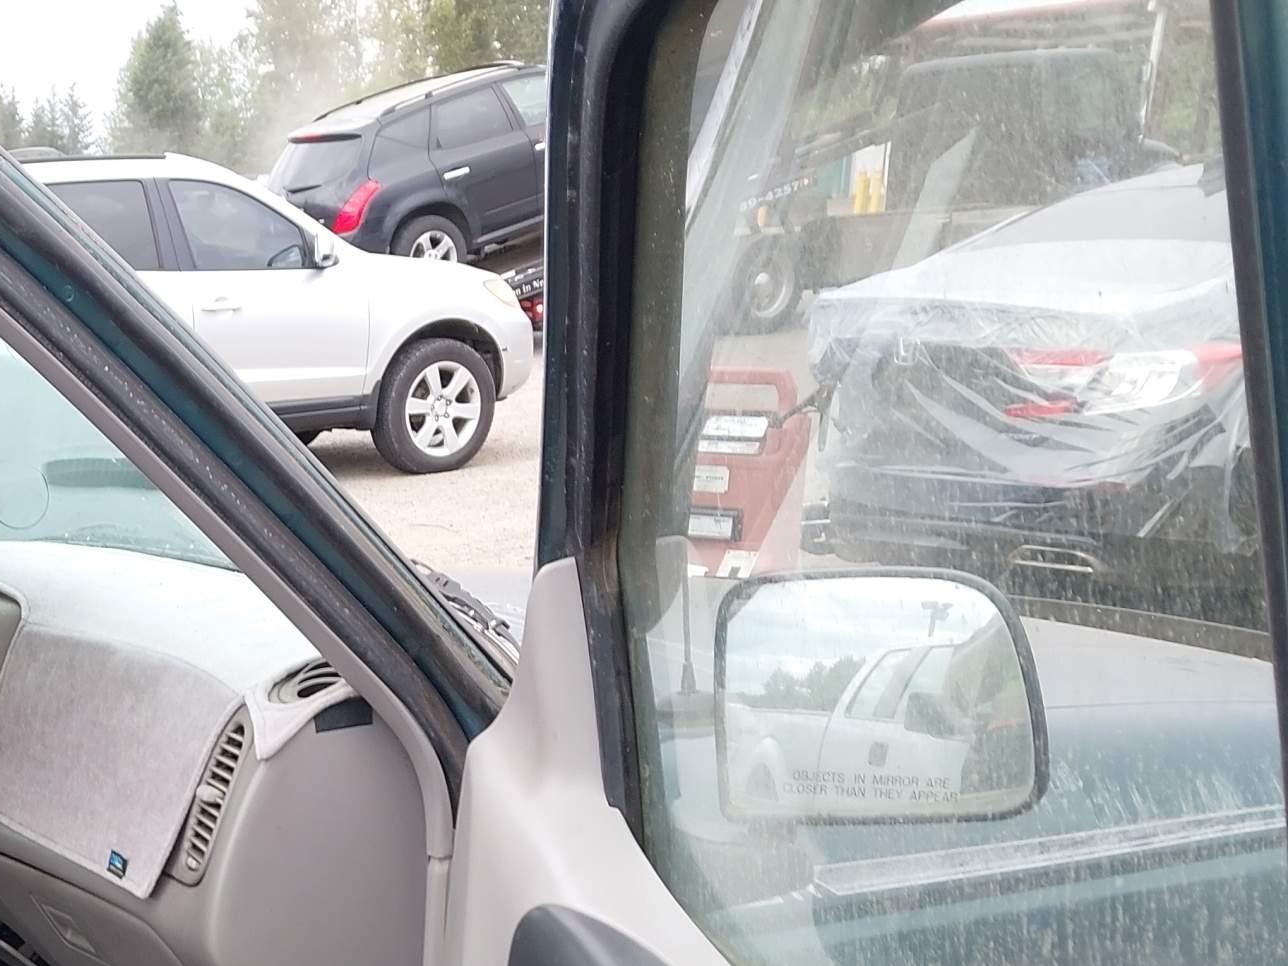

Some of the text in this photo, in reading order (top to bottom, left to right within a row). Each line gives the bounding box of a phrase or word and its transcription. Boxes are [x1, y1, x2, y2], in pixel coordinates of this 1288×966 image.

[792, 769, 952, 789] OBJECTS IN MIRROR ARE
[783, 782, 960, 803] CLOSER THAN THEY APPEAR
